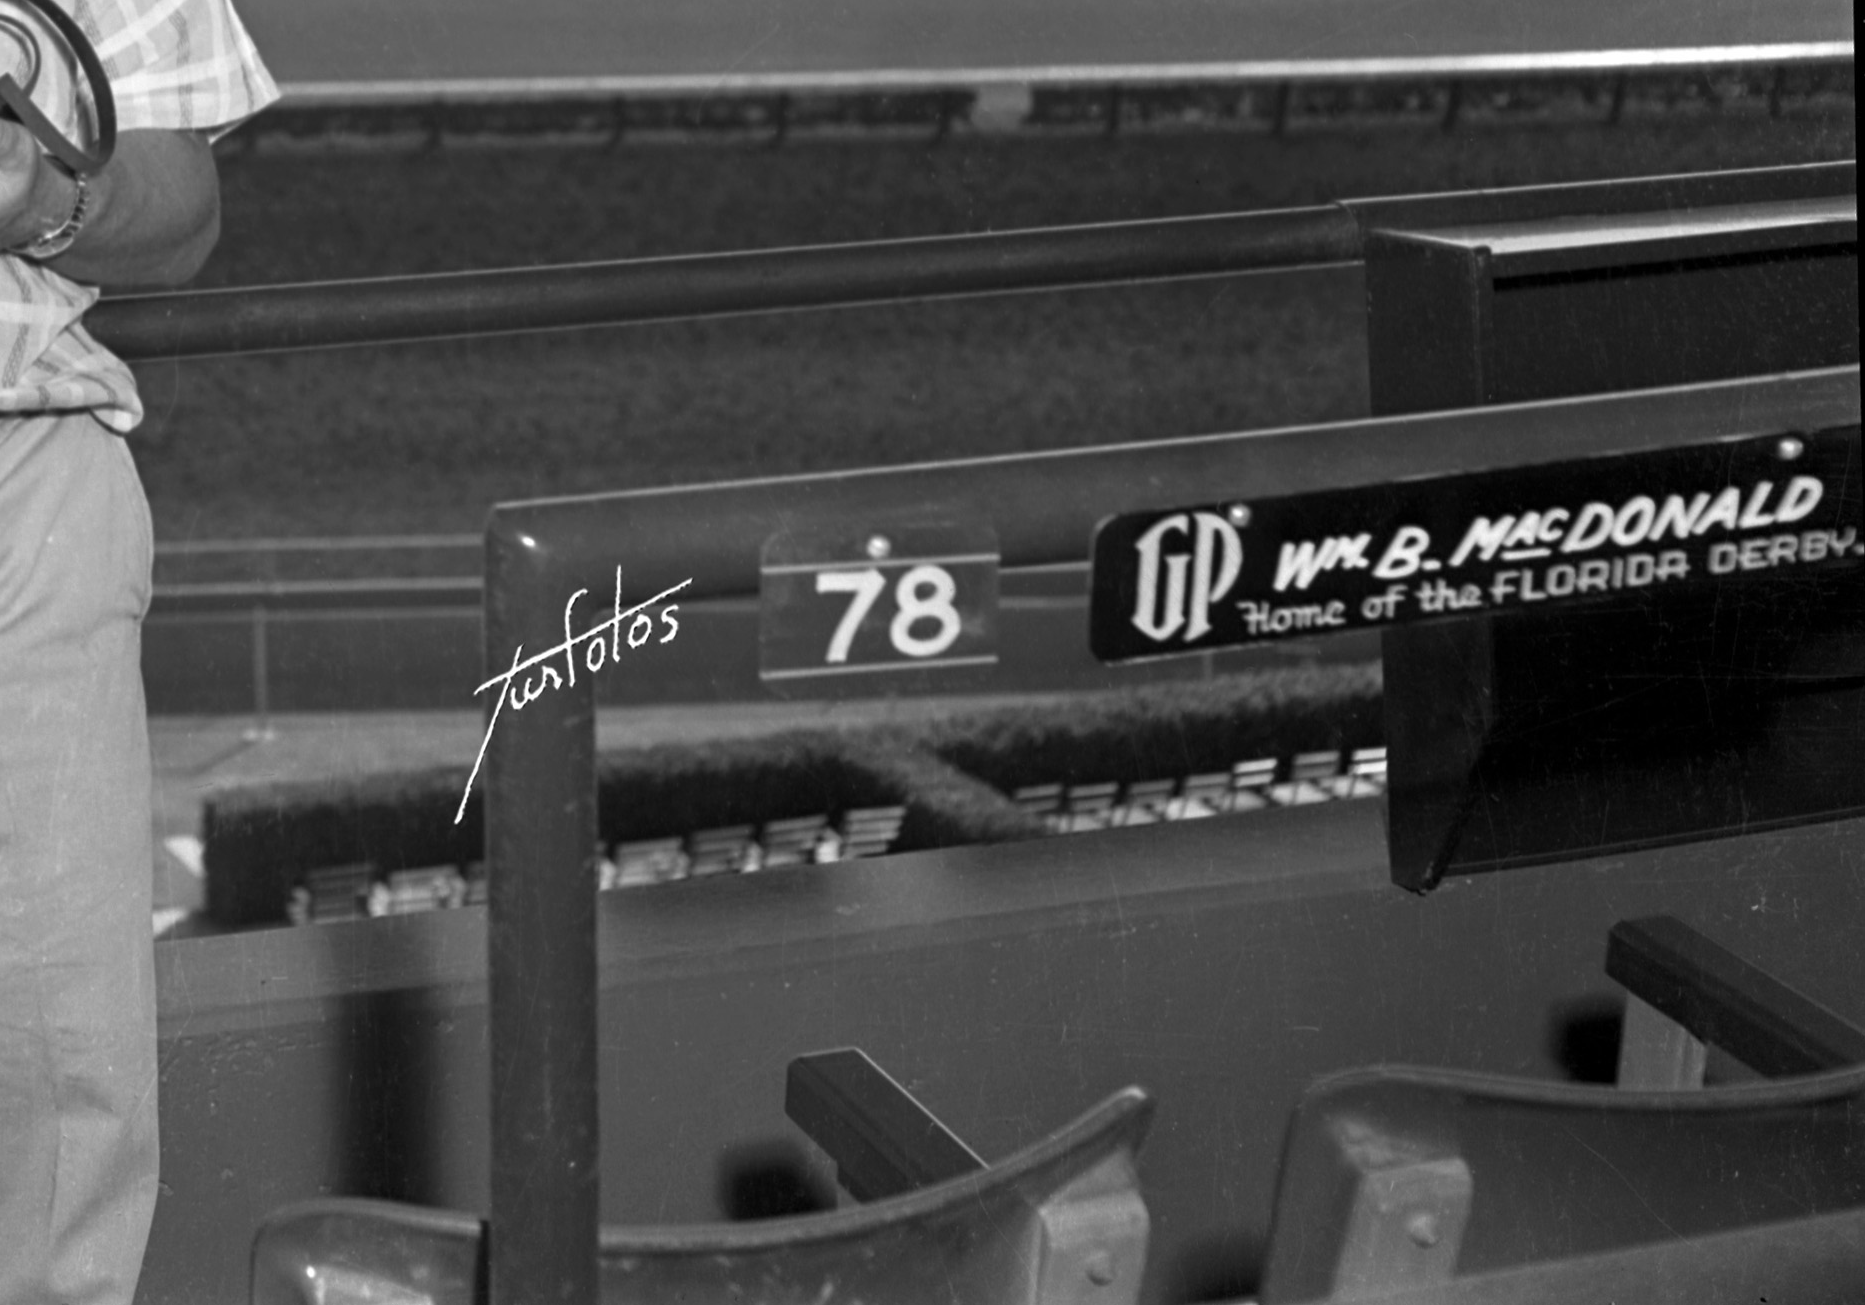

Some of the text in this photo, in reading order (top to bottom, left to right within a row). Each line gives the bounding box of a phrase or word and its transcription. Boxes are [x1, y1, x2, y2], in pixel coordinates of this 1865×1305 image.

[1131, 511, 1243, 641] GP
[1236, 600, 1346, 635] Home
[1362, 584, 1408, 619] of
[1416, 579, 1482, 612] the
[1489, 549, 1691, 603] FLORIDA
[1372, 526, 1441, 579] B.
[816, 564, 961, 662] 78
